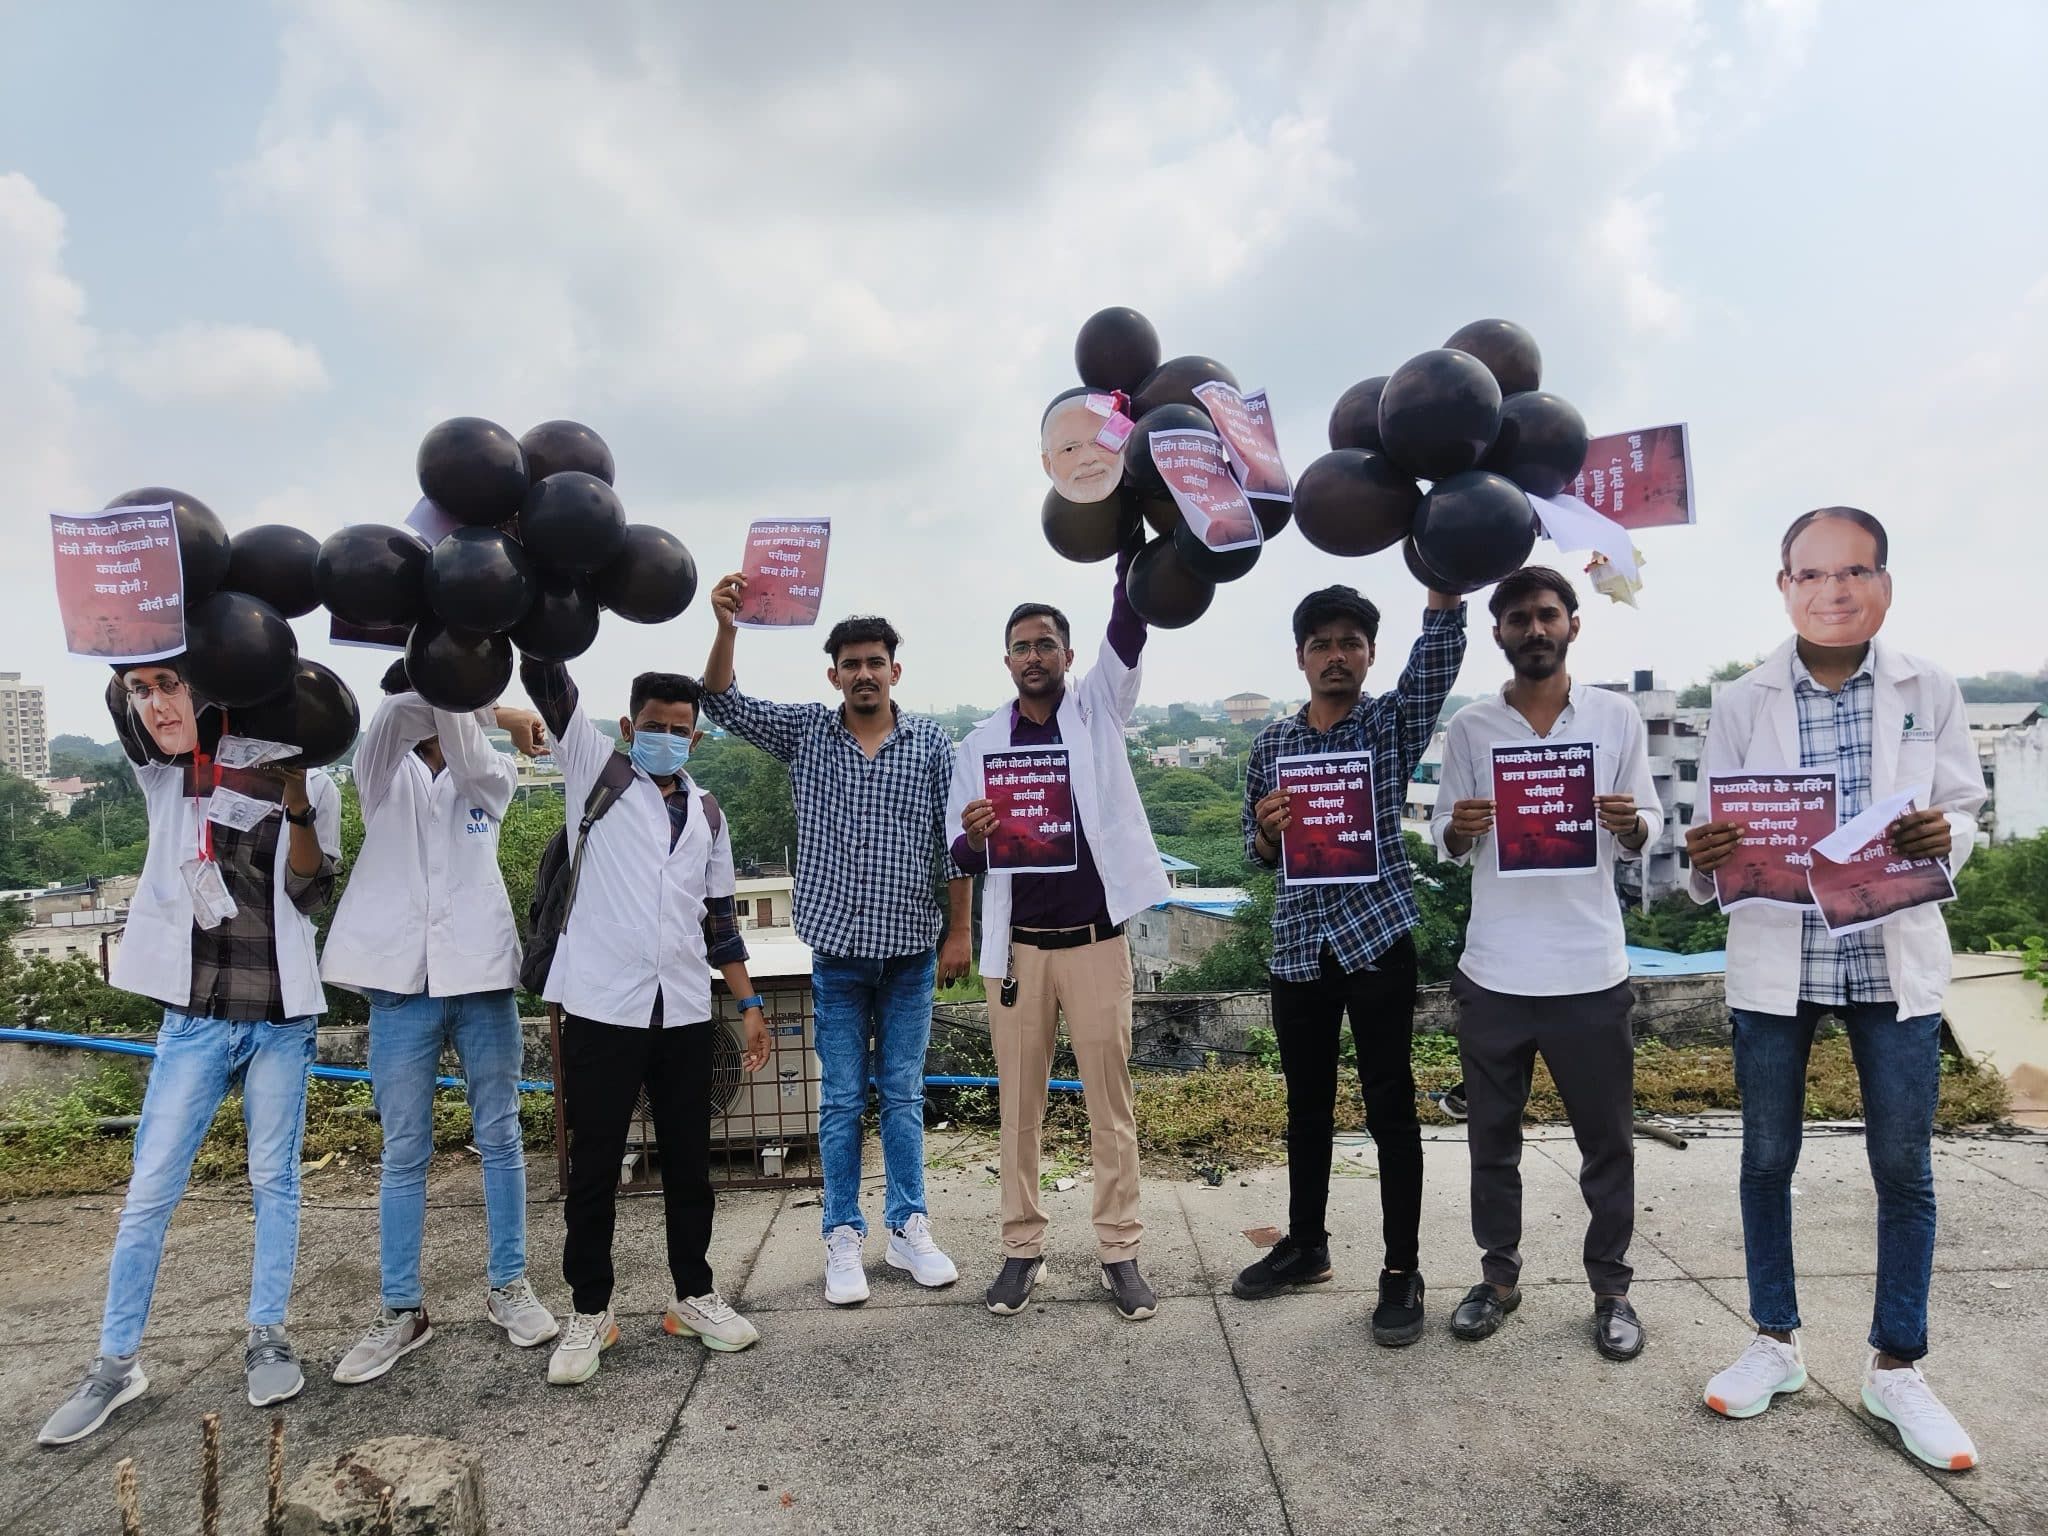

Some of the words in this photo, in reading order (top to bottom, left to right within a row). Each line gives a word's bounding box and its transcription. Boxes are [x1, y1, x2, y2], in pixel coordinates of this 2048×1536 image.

[54, 522, 85, 537] नर्सिंग
[88, 521, 119, 536] घोटाले
[120, 517, 145, 532] करने
[148, 516, 169, 528] वाले
[751, 525, 788, 534] मध्यप्रदेश
[791, 525, 800, 533] के
[803, 525, 828, 536] नर्सिंग
[59, 542, 79, 556] मंत्री
[83, 542, 102, 555] और
[155, 537, 169, 546] पर
[773, 537, 805, 547] छात्राओं
[806, 539, 821, 549] की
[768, 550, 801, 563] परीक्षाएं
[760, 566, 778, 576] कब
[780, 566, 798, 578] होगी
[800, 570, 806, 578] ?
[95, 584, 117, 594] कब
[119, 579, 141, 595] होगी
[143, 581, 148, 590] ?
[789, 585, 806, 596] मोदी
[808, 587, 819, 597] जी
[138, 596, 163, 612] मोदी
[165, 593, 179, 607] जी
[1495, 750, 1542, 763] मध्यप्रदेश
[1544, 749, 1558, 761] के
[1559, 746, 1591, 760] नर्सिंग
[986, 758, 1007, 769] नर्सिंग
[1009, 756, 1031, 768] घोटाले
[1033, 755, 1051, 767] करने
[1053, 755, 1066, 766] वाले
[1281, 765, 1323, 777] मध्यप्रदेश
[1325, 763, 1337, 774] के
[1339, 761, 1367, 774] नर्सिंग
[1502, 771, 1525, 781] छात्र
[1527, 765, 1566, 779] छात्राओं
[1568, 765, 1585, 777] की
[989, 774, 1003, 786] मंत्री
[1005, 774, 1018, 785] और
[1056, 774, 1066, 783] पर
[1287, 784, 1308, 793] छात्र
[1310, 779, 1345, 792] छात्राओं
[1347, 778, 1363, 790] की
[1713, 779, 1771, 793] मध्यप्रदेश
[1773, 779, 1790, 793] के
[1792, 778, 1832, 792] नर्सिंग
[1524, 783, 1565, 797] परीक्षाएं
[1308, 796, 1345, 809] परीक्षाएं
[1517, 805, 1540, 814] कब
[1542, 801, 1564, 814] होगी
[1567, 804, 1573, 813] ?
[1722, 802, 1749, 812] छात्र
[1752, 798, 1800, 812] छात्राओं
[1803, 797, 1824, 810] की
[1010, 808, 1025, 817] कब
[1027, 805, 1043, 817] होगी
[1044, 808, 1049, 816] ?
[1302, 816, 1322, 825] कब
[1324, 812, 1345, 825] होगी
[1347, 815, 1353, 823] ?
[1748, 817, 1798, 830] परीक्षाएं
[466, 823, 489, 834] SAM
[1039, 822, 1058, 833] मोदी
[1060, 821, 1071, 832] जी
[1555, 820, 1578, 832] मोदी
[1579, 819, 1593, 831] जी
[1337, 831, 1358, 842] मोदी
[1359, 830, 1372, 841] जी
[1769, 834, 1797, 846] होगी
[1800, 837, 1808, 845] ?
[1863, 844, 1884, 861] होगी
[1886, 846, 1892, 855] ?
[1884, 860, 1912, 873] मोदी
